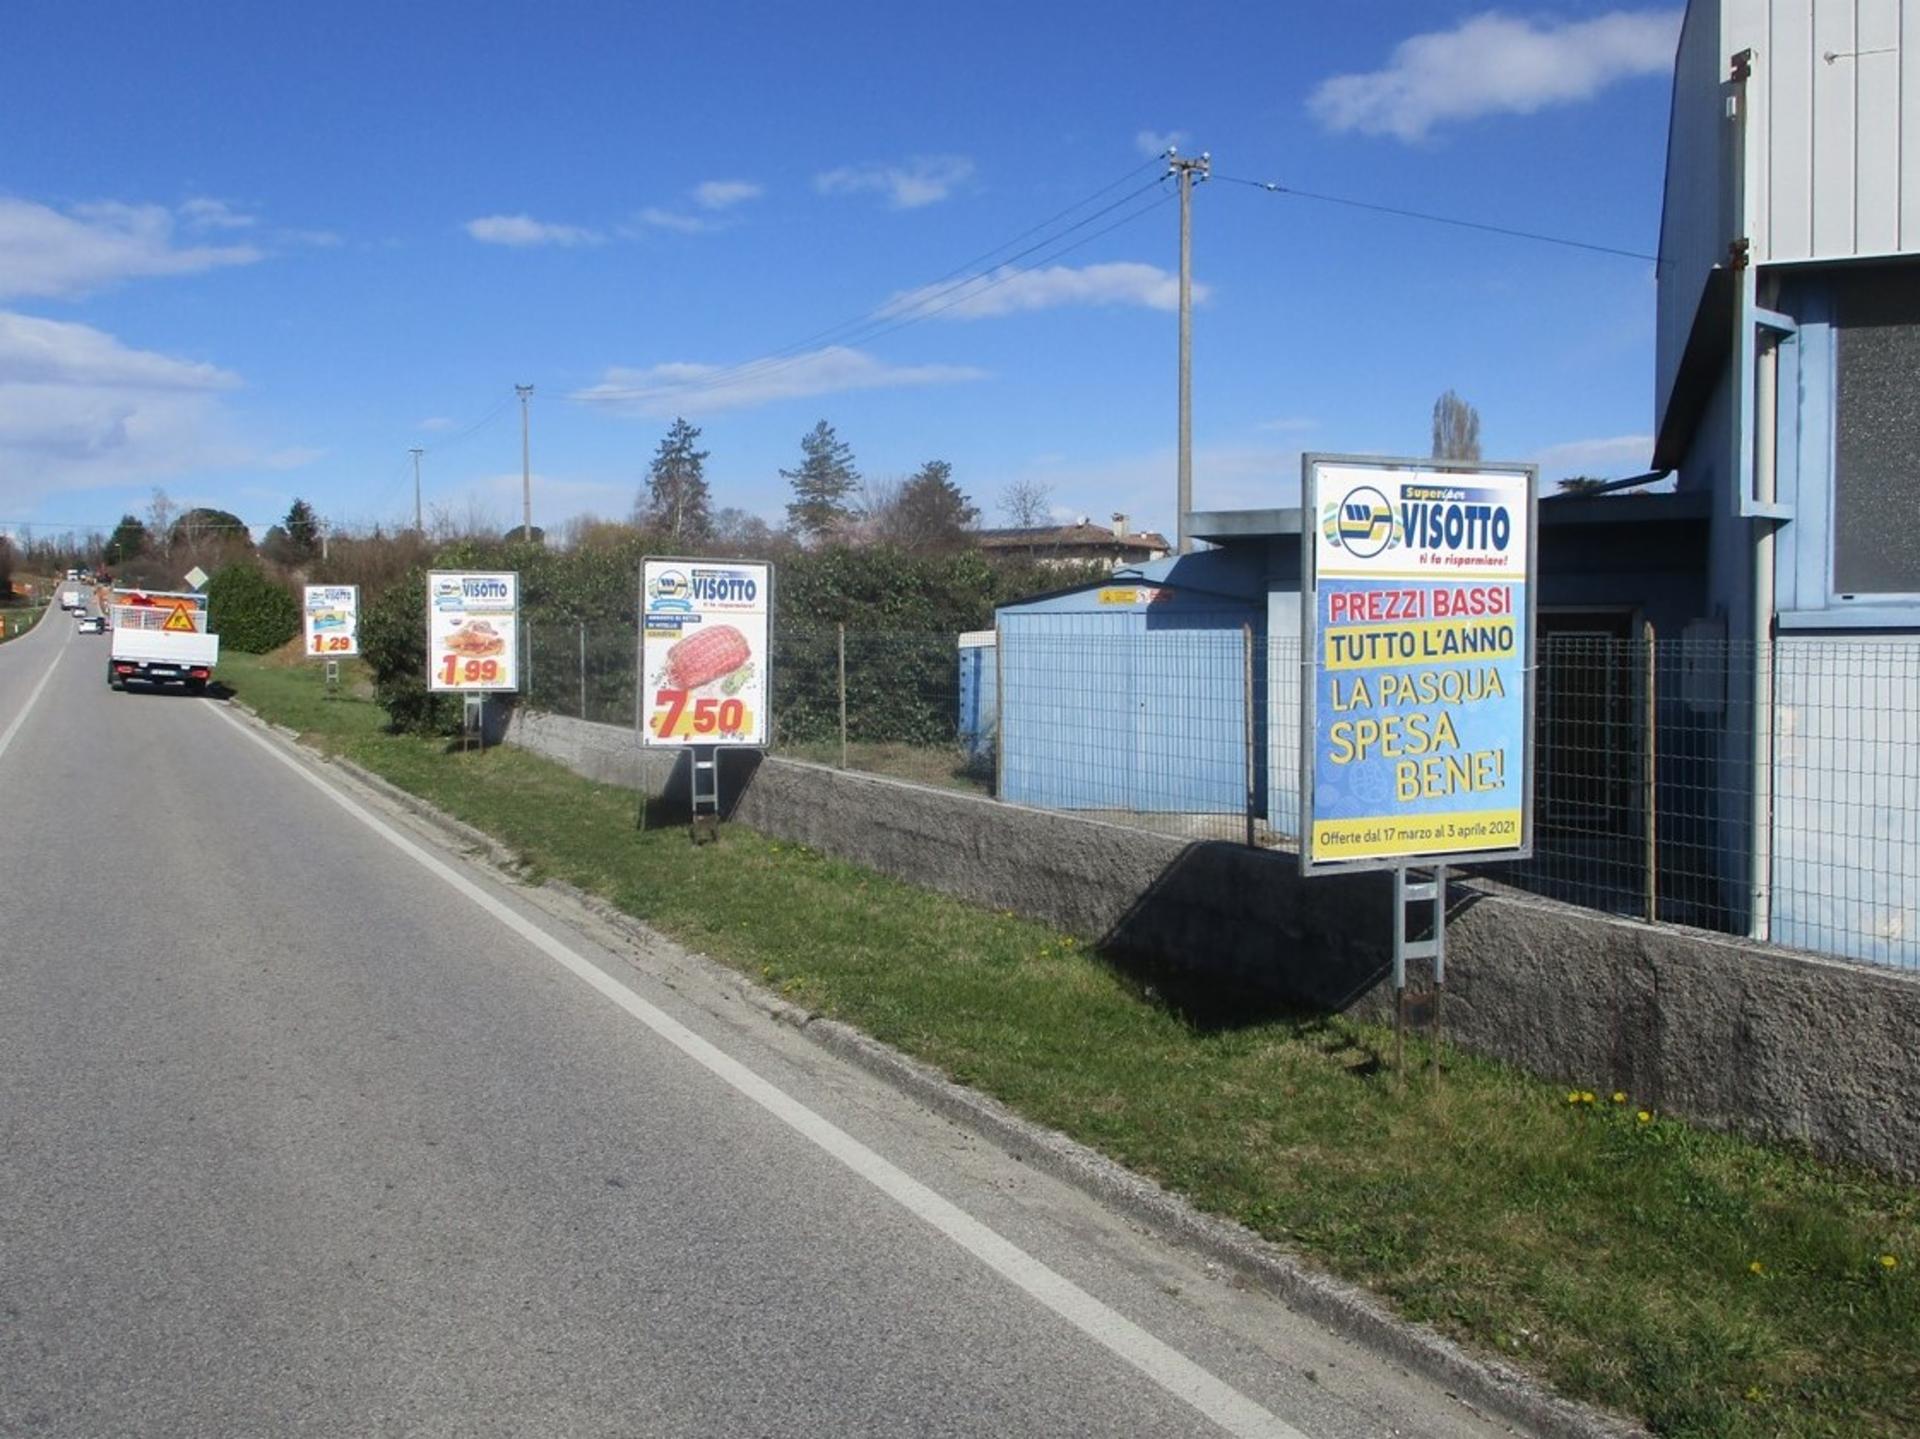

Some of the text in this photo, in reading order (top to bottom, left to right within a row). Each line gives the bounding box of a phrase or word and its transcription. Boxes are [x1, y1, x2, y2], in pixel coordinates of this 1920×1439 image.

[1400, 503, 1510, 551] VISOTTO
[1420, 555, 1509, 568] ti fa risparmiare!
[462, 583, 508, 597] VISOTTO
[692, 578, 757, 601] VISOTTO
[1329, 586, 1511, 622] PREZZI BASSI
[1331, 625, 1514, 662] TUTTO L'ANNO
[1331, 666, 1506, 711] LA PASQUA
[1328, 711, 1460, 765] SPESA
[1396, 748, 1506, 803] BENE!
[1320, 820, 1516, 846] Offerte dal 17 marzo al 3 aprile 2021
